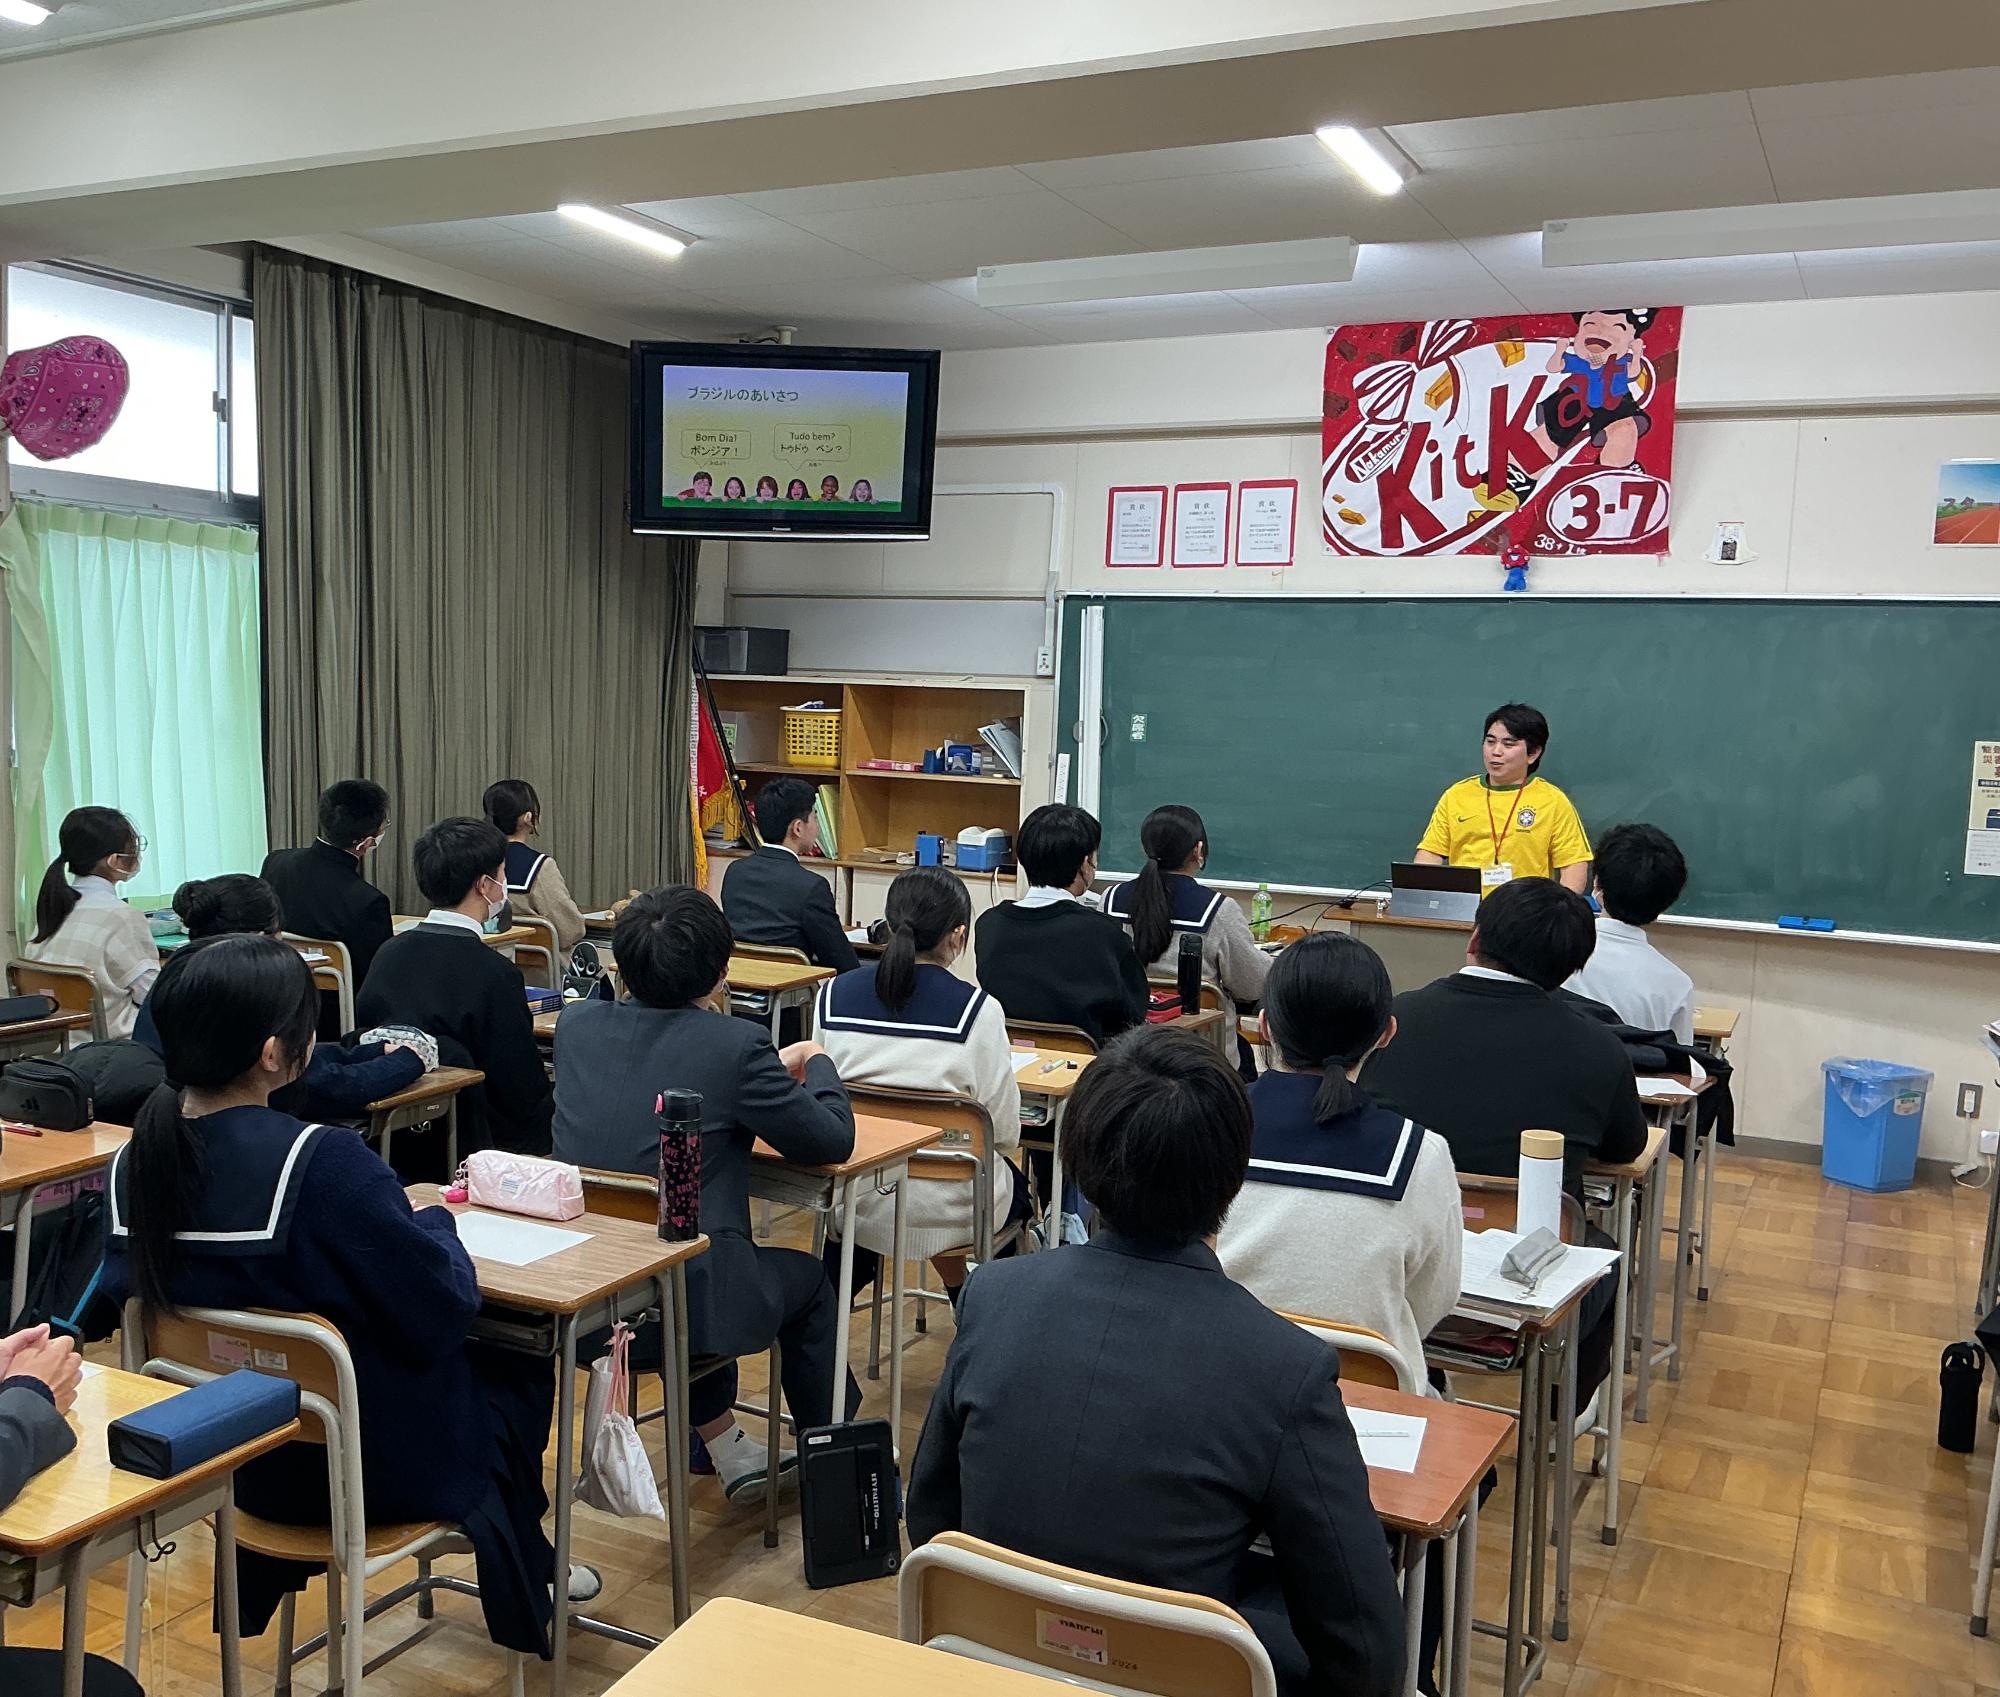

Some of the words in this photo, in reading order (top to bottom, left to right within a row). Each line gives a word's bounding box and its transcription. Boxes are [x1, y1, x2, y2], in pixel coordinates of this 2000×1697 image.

[688, 386, 799, 402] ブラジルのあいさつ
[695, 433, 717, 442] Bom
[790, 432, 810, 441] Tudo
[812, 432, 836, 441] bem?
